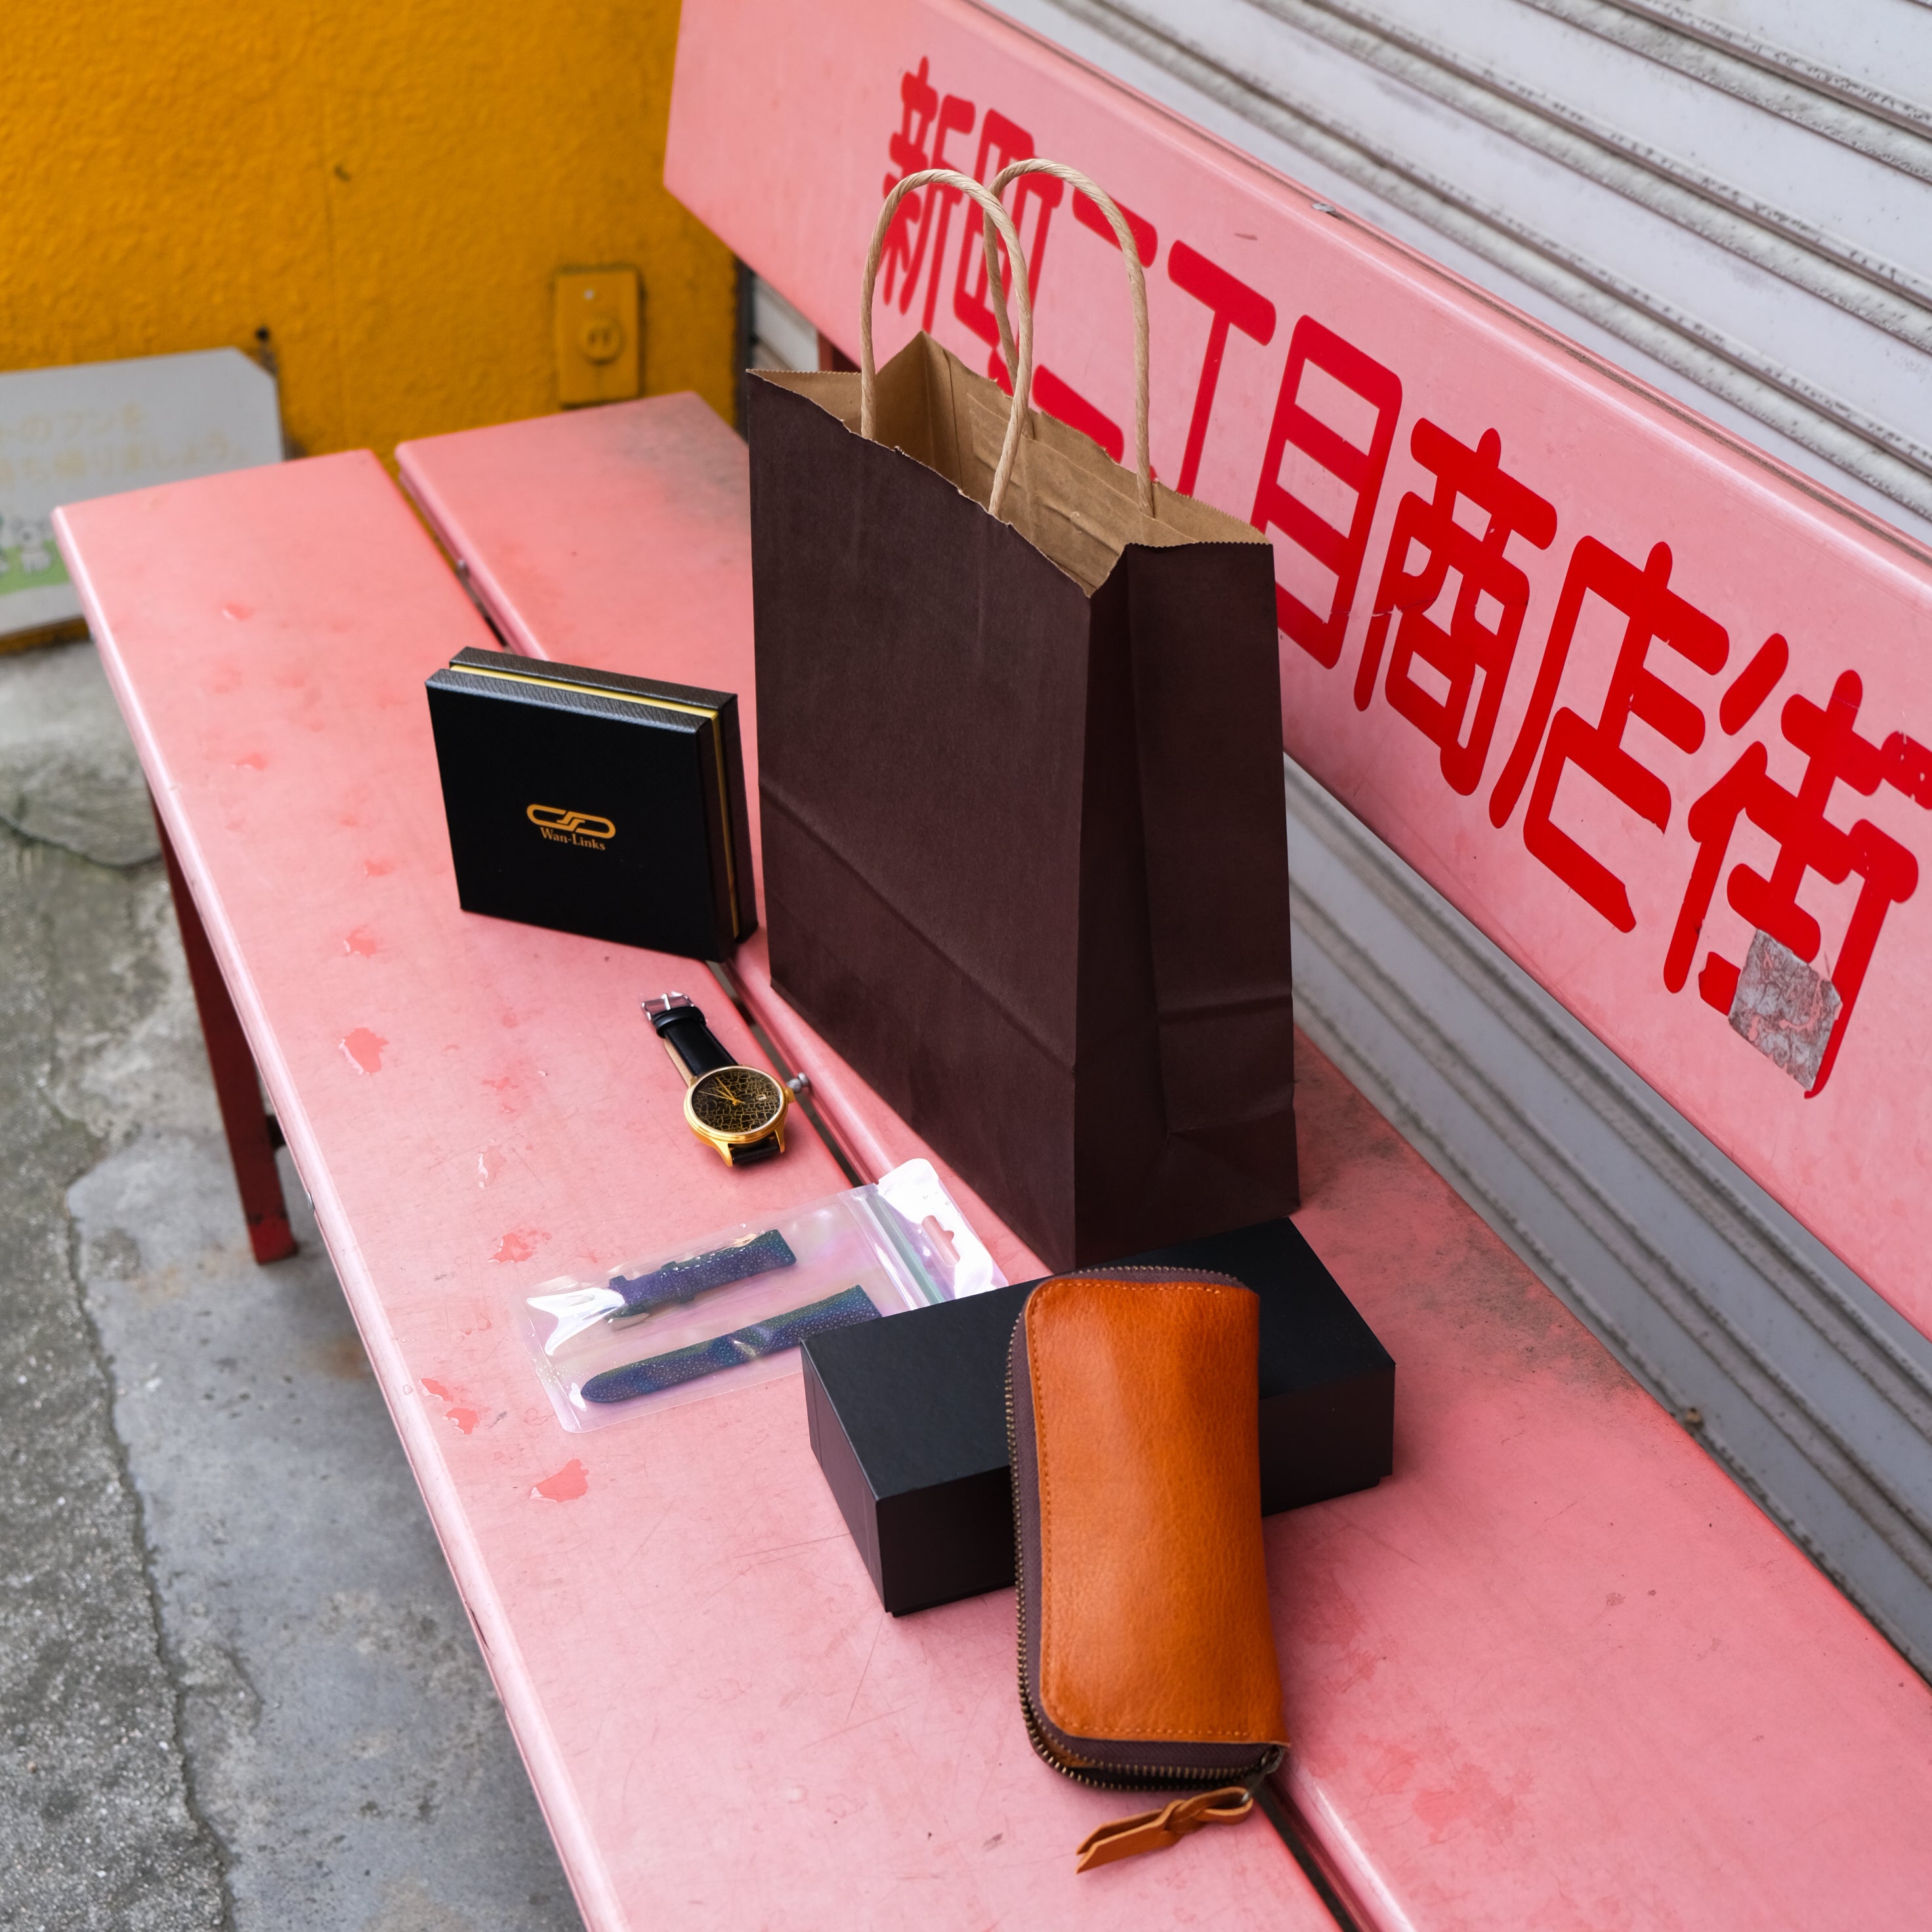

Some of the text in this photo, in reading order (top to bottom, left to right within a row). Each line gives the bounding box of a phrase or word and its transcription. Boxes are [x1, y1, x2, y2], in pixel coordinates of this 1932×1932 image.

[540, 826, 606, 850] Wan-Links
[877, 56, 1932, 1100] 新町二丁目商店街
